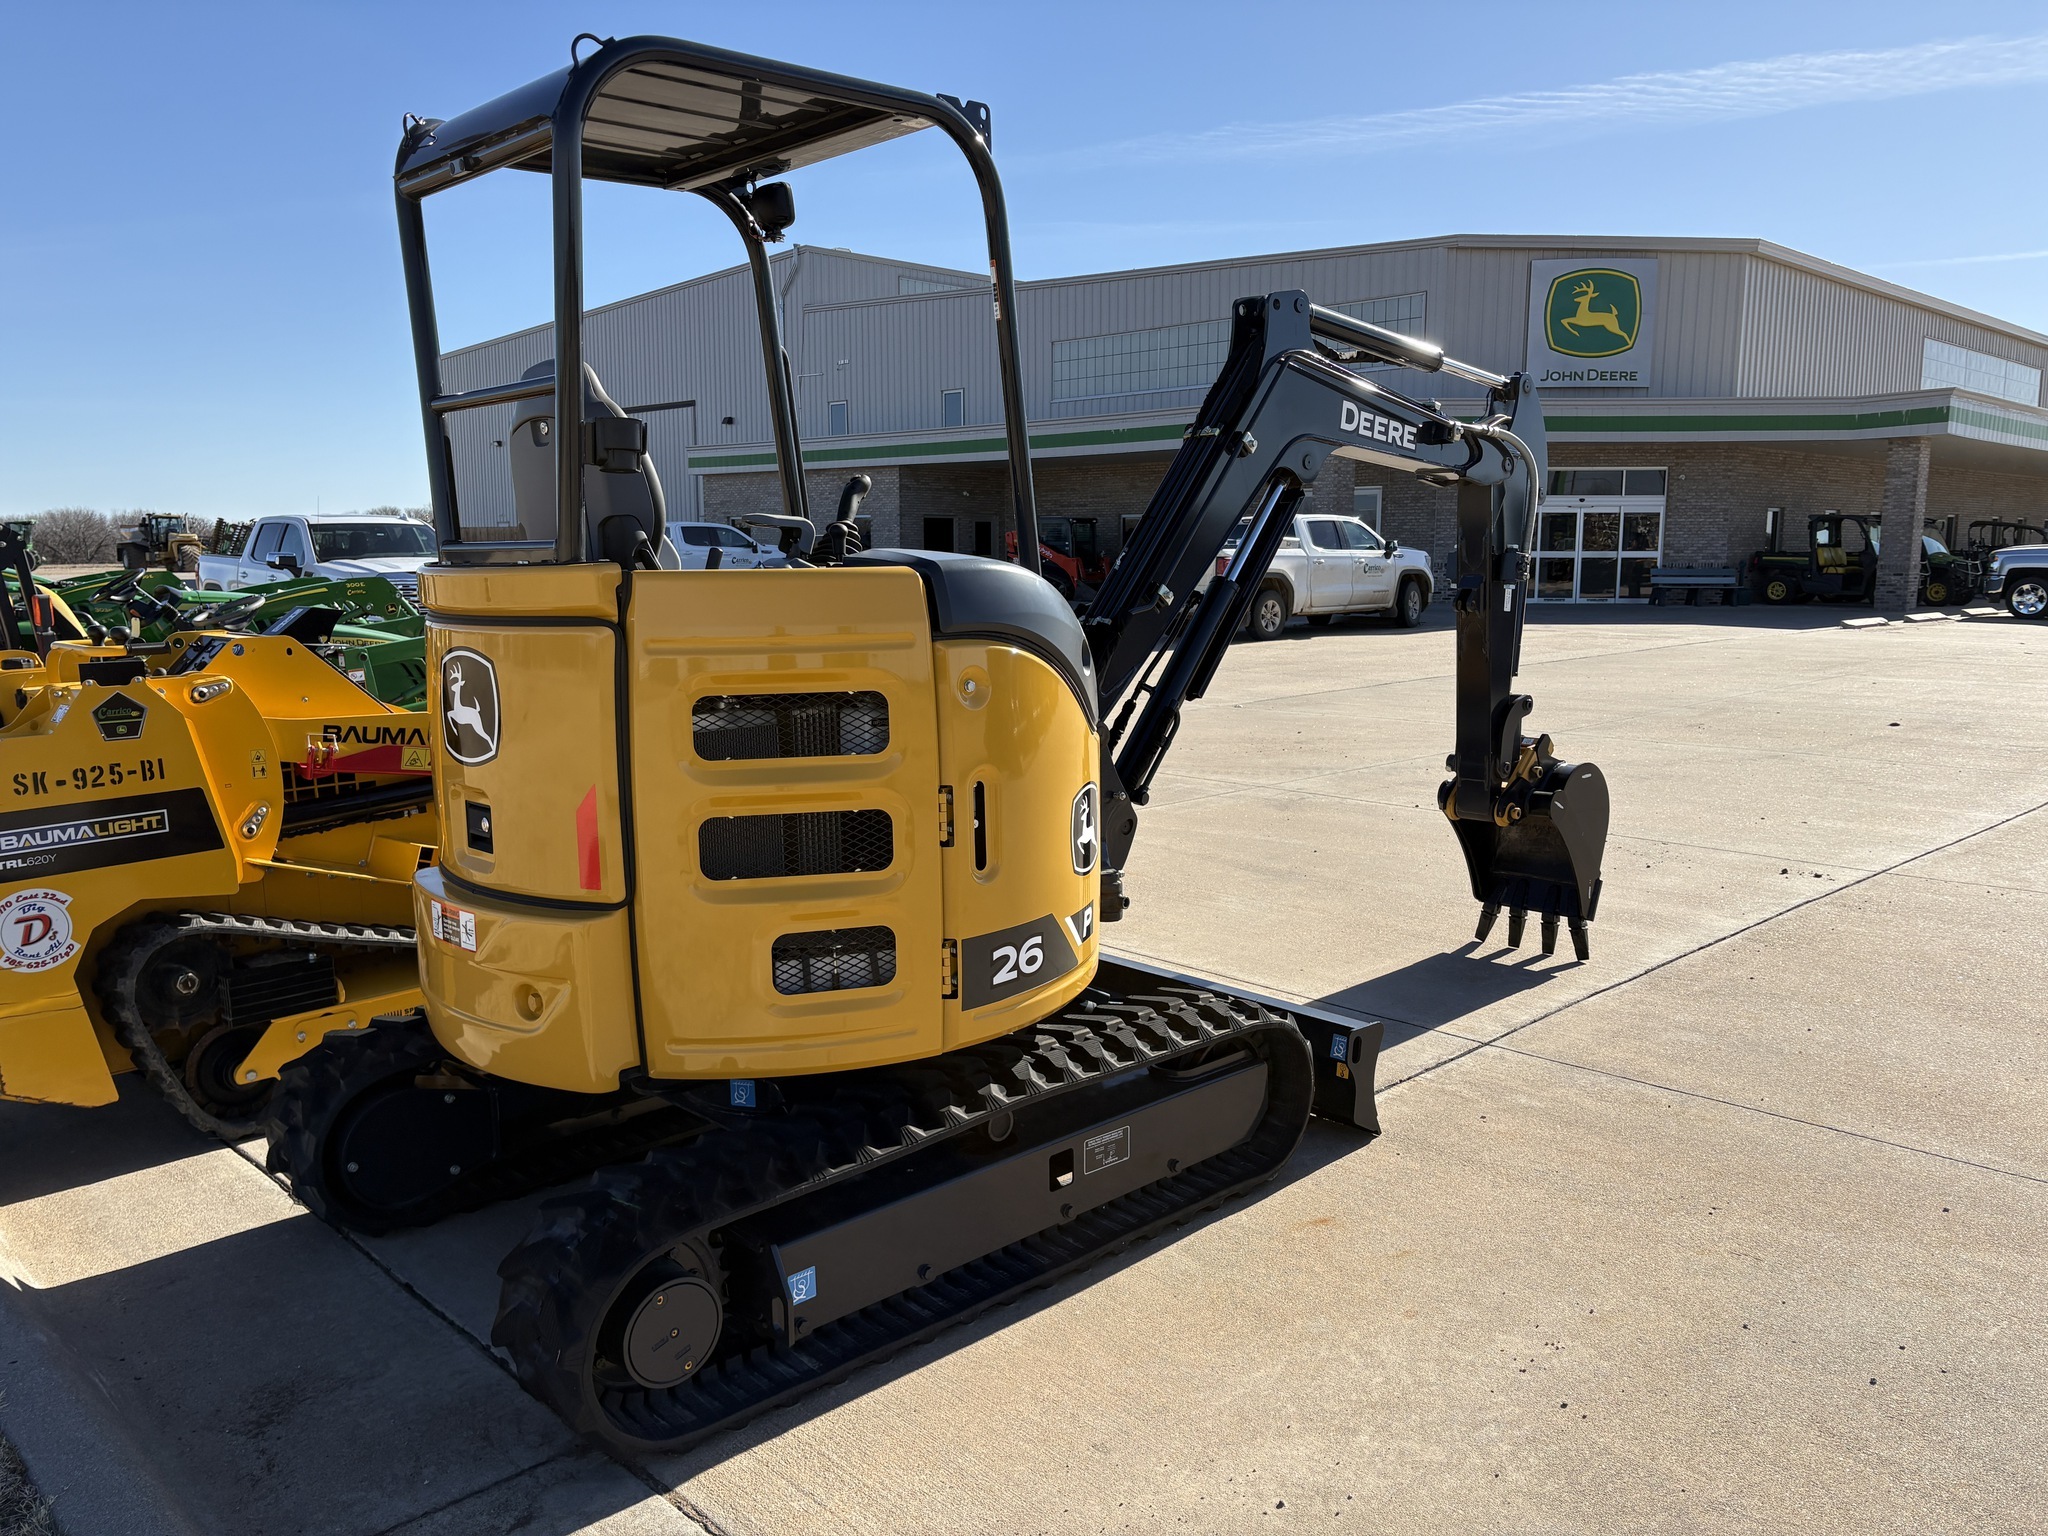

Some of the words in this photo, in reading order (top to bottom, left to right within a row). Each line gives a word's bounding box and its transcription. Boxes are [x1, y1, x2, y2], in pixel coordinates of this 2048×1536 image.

[1540, 369, 1584, 382] JOHN
[1587, 369, 1638, 381] DEERE
[1340, 399, 1418, 450] DEERE
[97, 707, 132, 719] Carrico
[0, 814, 162, 850] BAUMALIGHT
[15, 893, 39, 903] East
[41, 892, 69, 906] 22nd
[17, 903, 47, 915] Big
[14, 946, 42, 959] Rent
[44, 939, 63, 956] All
[992, 935, 1044, 986] 26
